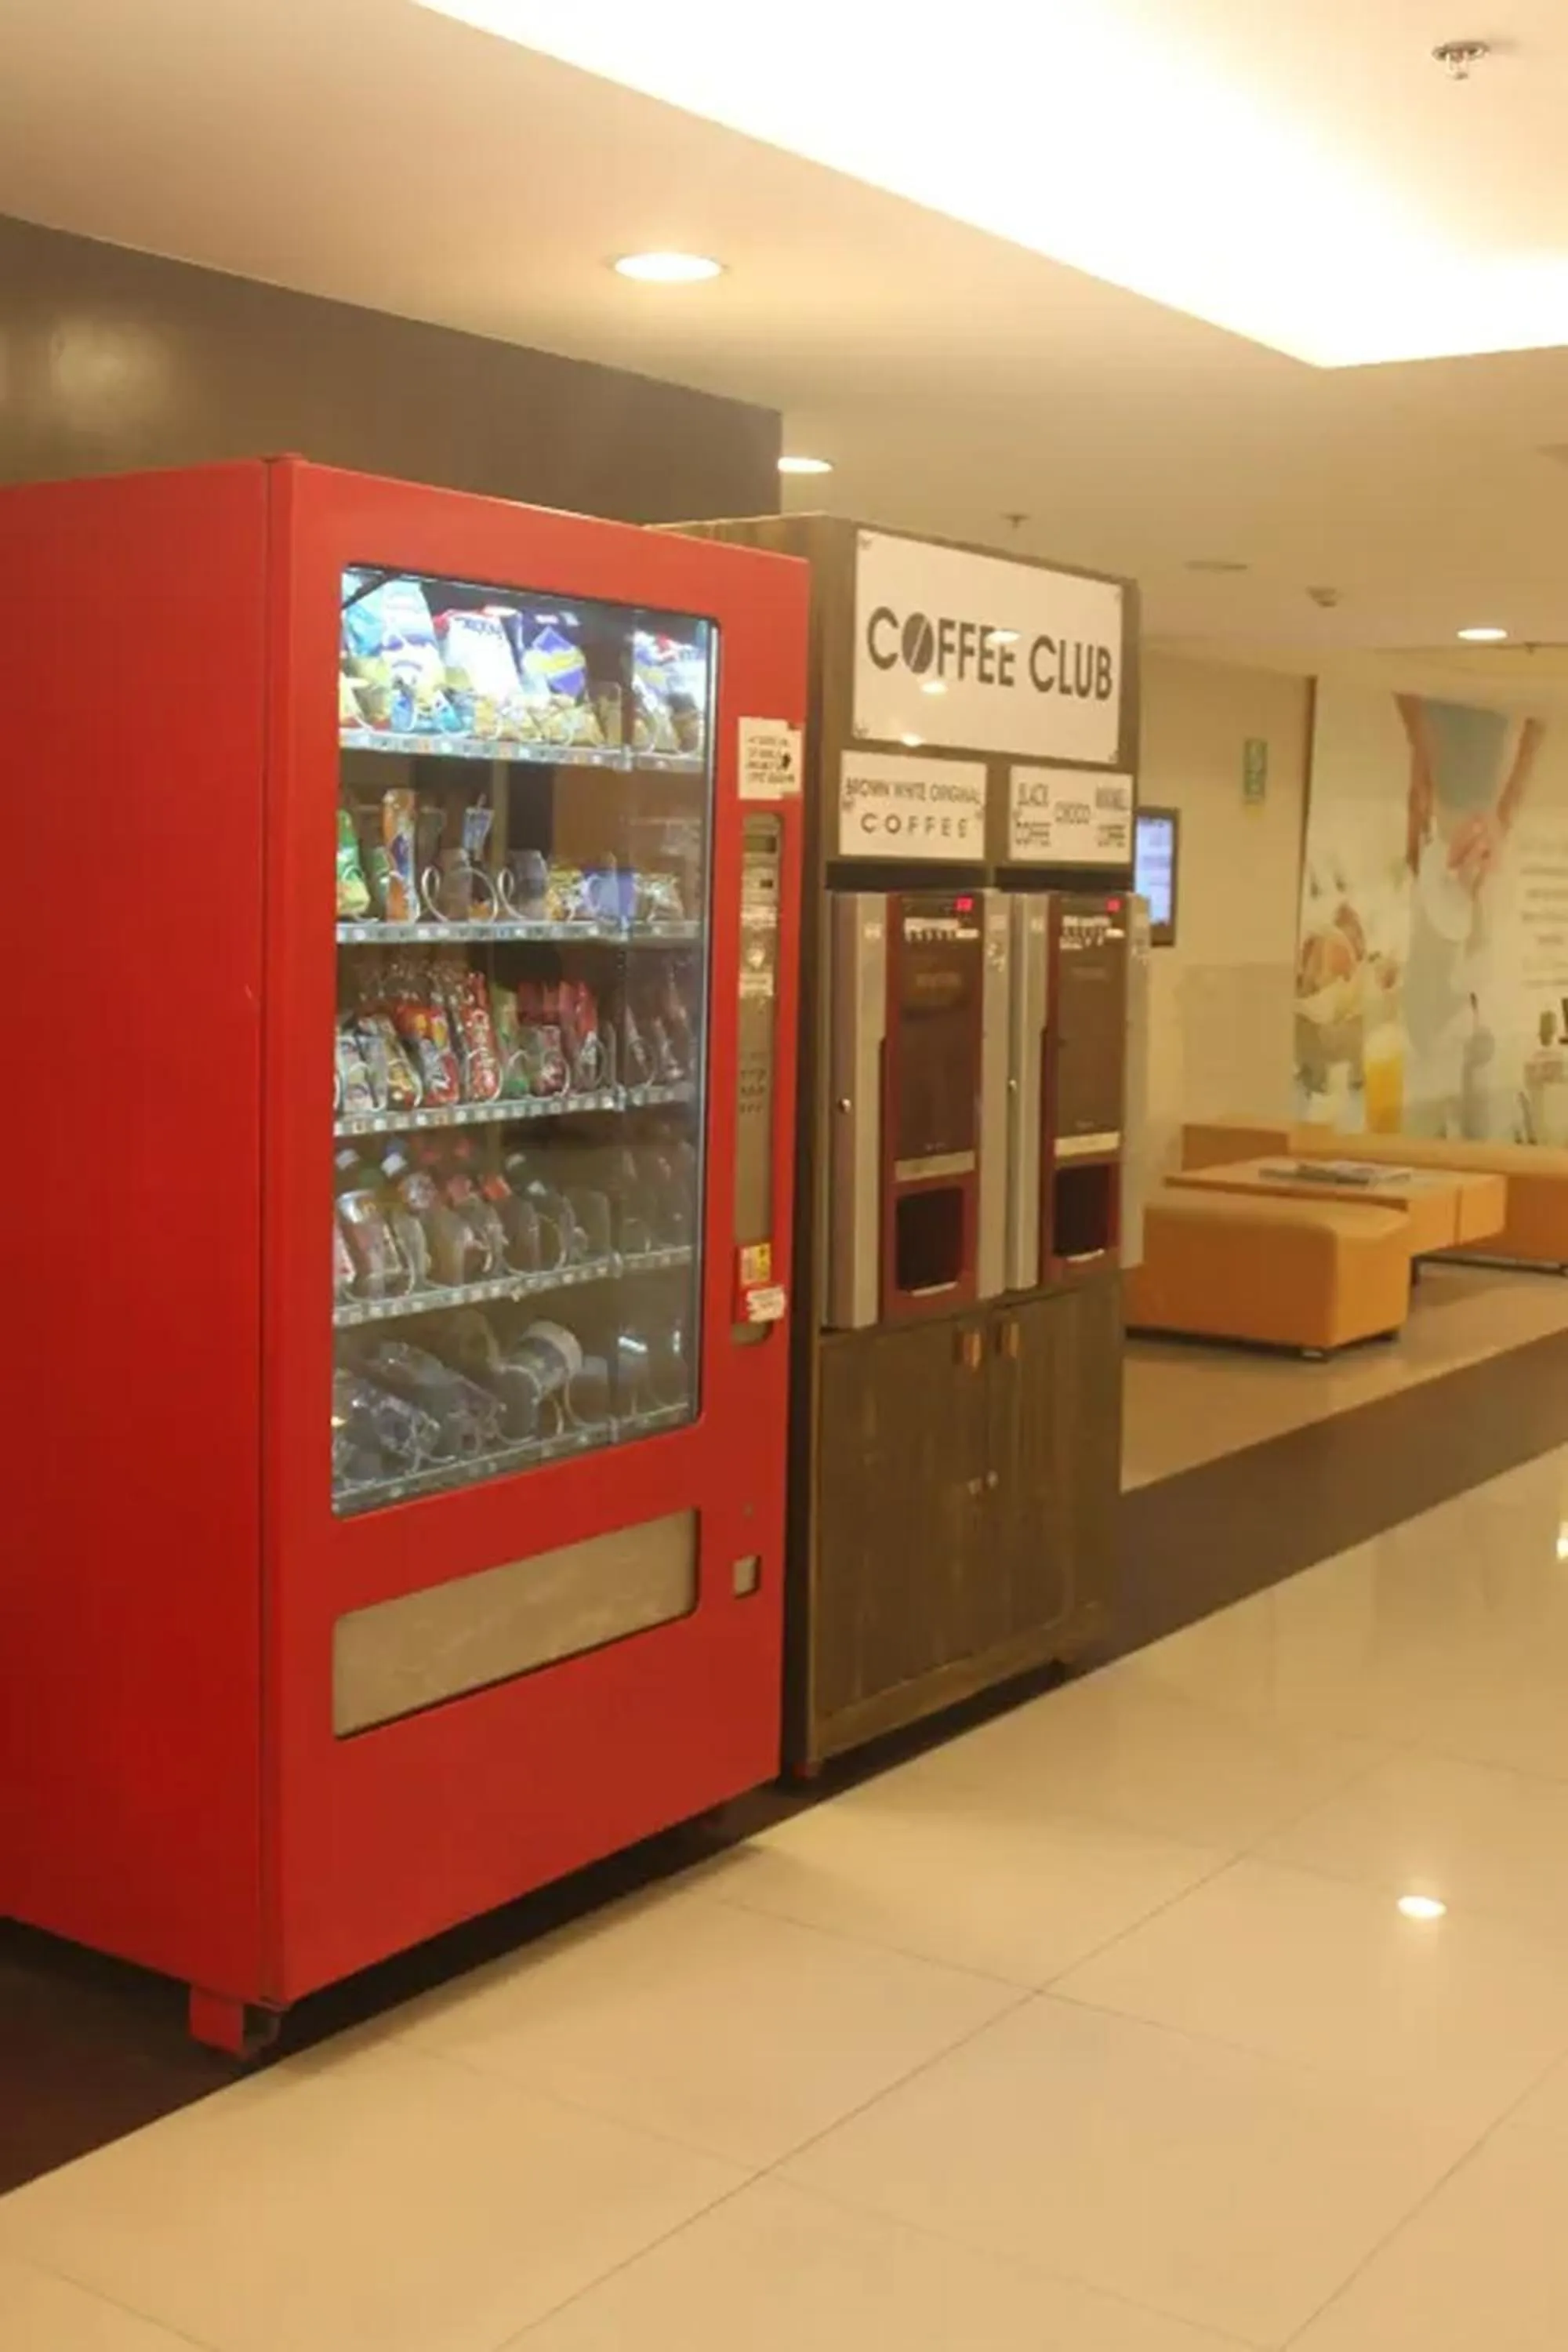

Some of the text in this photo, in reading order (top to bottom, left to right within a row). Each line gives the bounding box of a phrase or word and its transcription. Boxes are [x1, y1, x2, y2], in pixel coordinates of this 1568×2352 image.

[867, 606, 1113, 701] COFFEE CLUB
[860, 811, 968, 839] COFFEE
